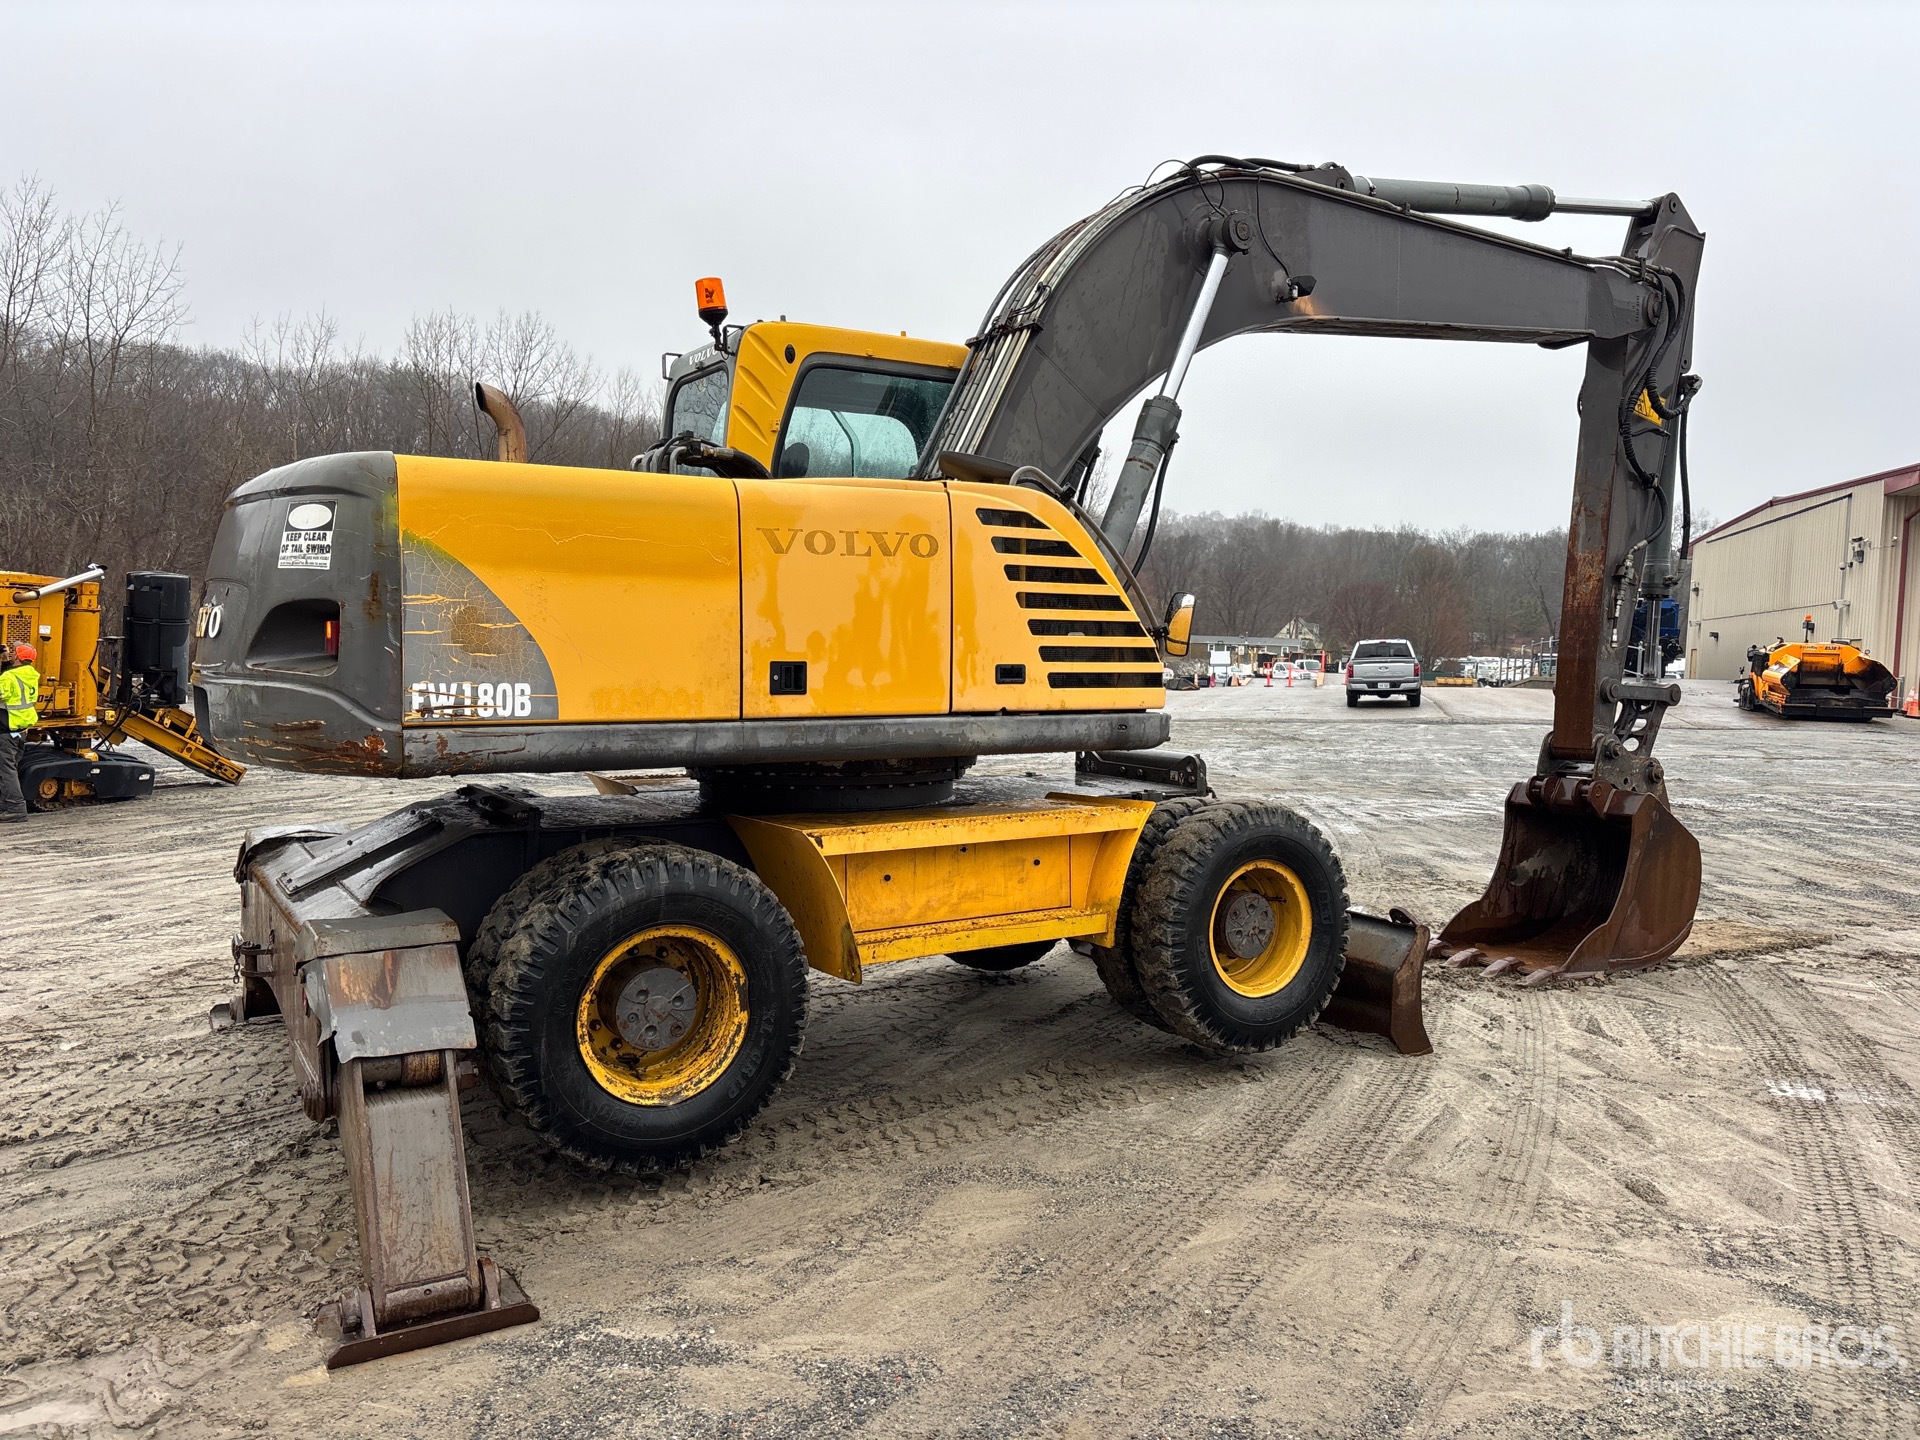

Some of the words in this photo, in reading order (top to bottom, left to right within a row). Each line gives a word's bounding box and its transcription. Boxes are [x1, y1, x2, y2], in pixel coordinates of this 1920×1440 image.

[689, 346, 718, 365] VOLV
[286, 532, 302, 541] KEEP
[304, 532, 327, 542] CLEAR
[756, 527, 939, 558] VOLVO
[281, 544, 289, 553] OF
[291, 544, 304, 553] TAIL
[306, 544, 332, 554] SWING
